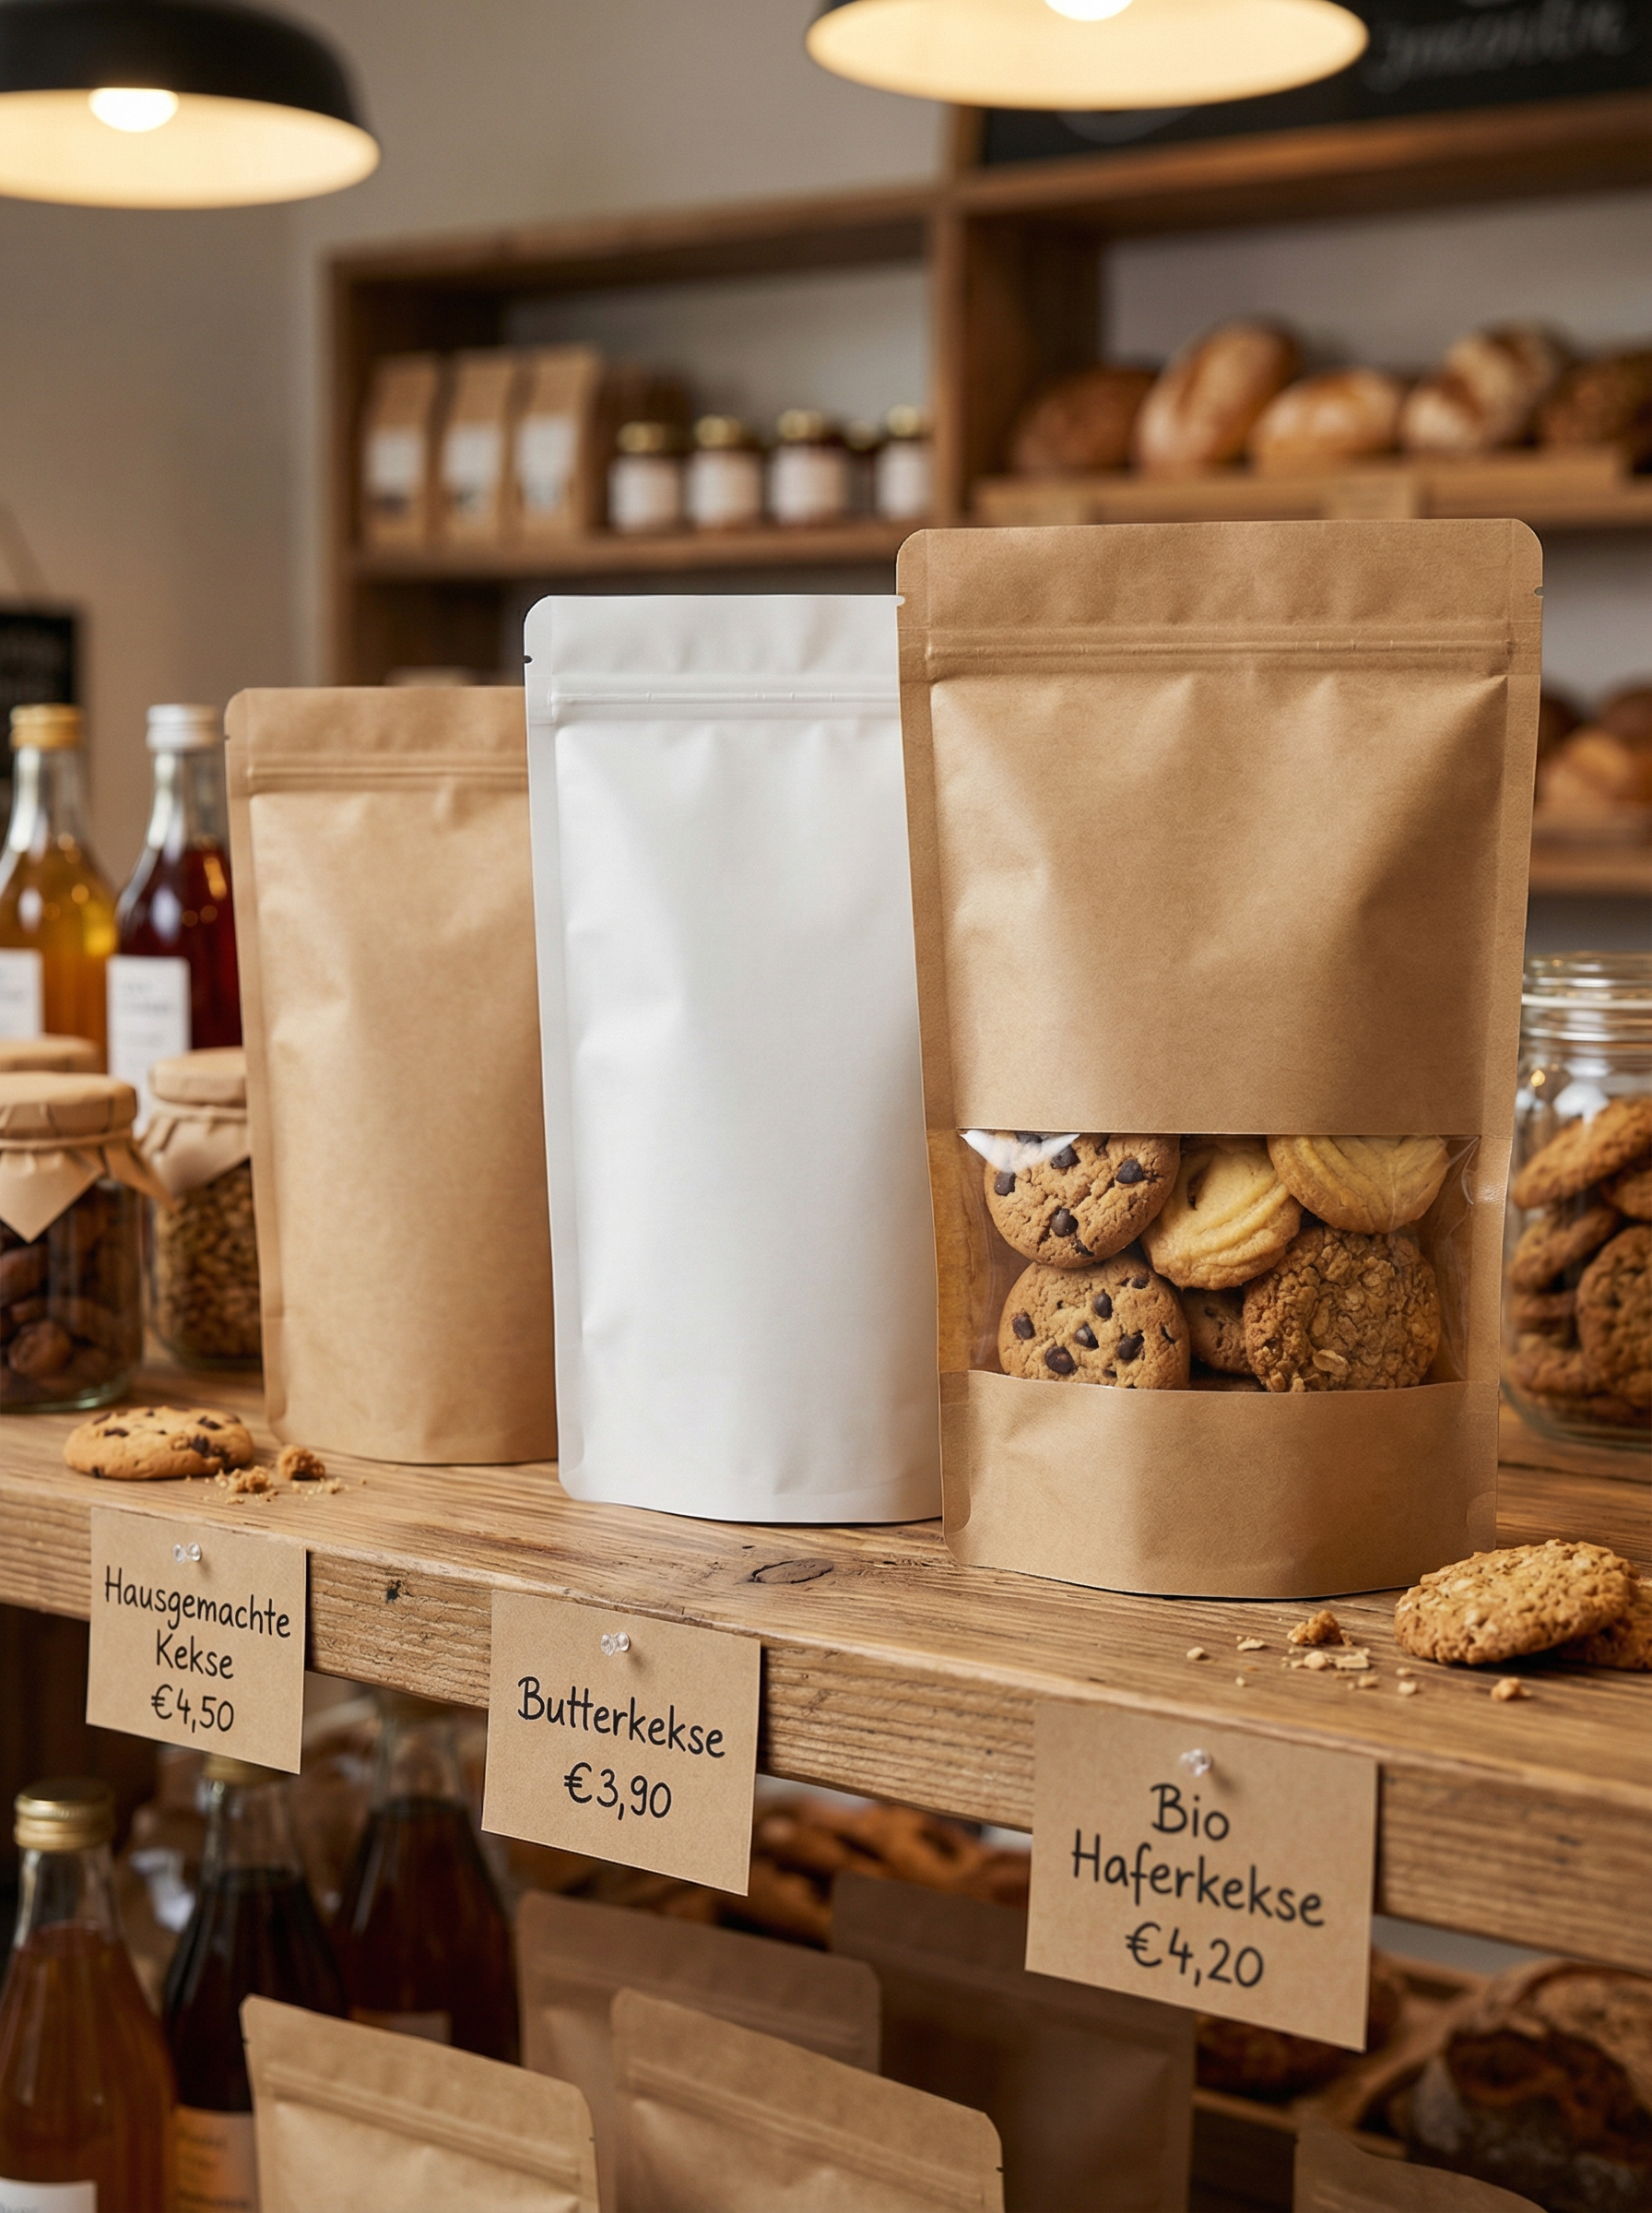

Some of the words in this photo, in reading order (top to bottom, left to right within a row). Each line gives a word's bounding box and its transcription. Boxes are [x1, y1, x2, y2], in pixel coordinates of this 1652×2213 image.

[104, 1565, 291, 1639] Hausgemachte
[156, 1628, 234, 1680] Kekse
[150, 1684, 234, 1734] €4,50
[517, 1675, 726, 1758] Butterkekse
[563, 1761, 672, 1821] €3,90
[1150, 1782, 1231, 1842] Bio
[1071, 1828, 1325, 1928] Haferkekse
[1125, 1921, 1265, 1989] €4,20
